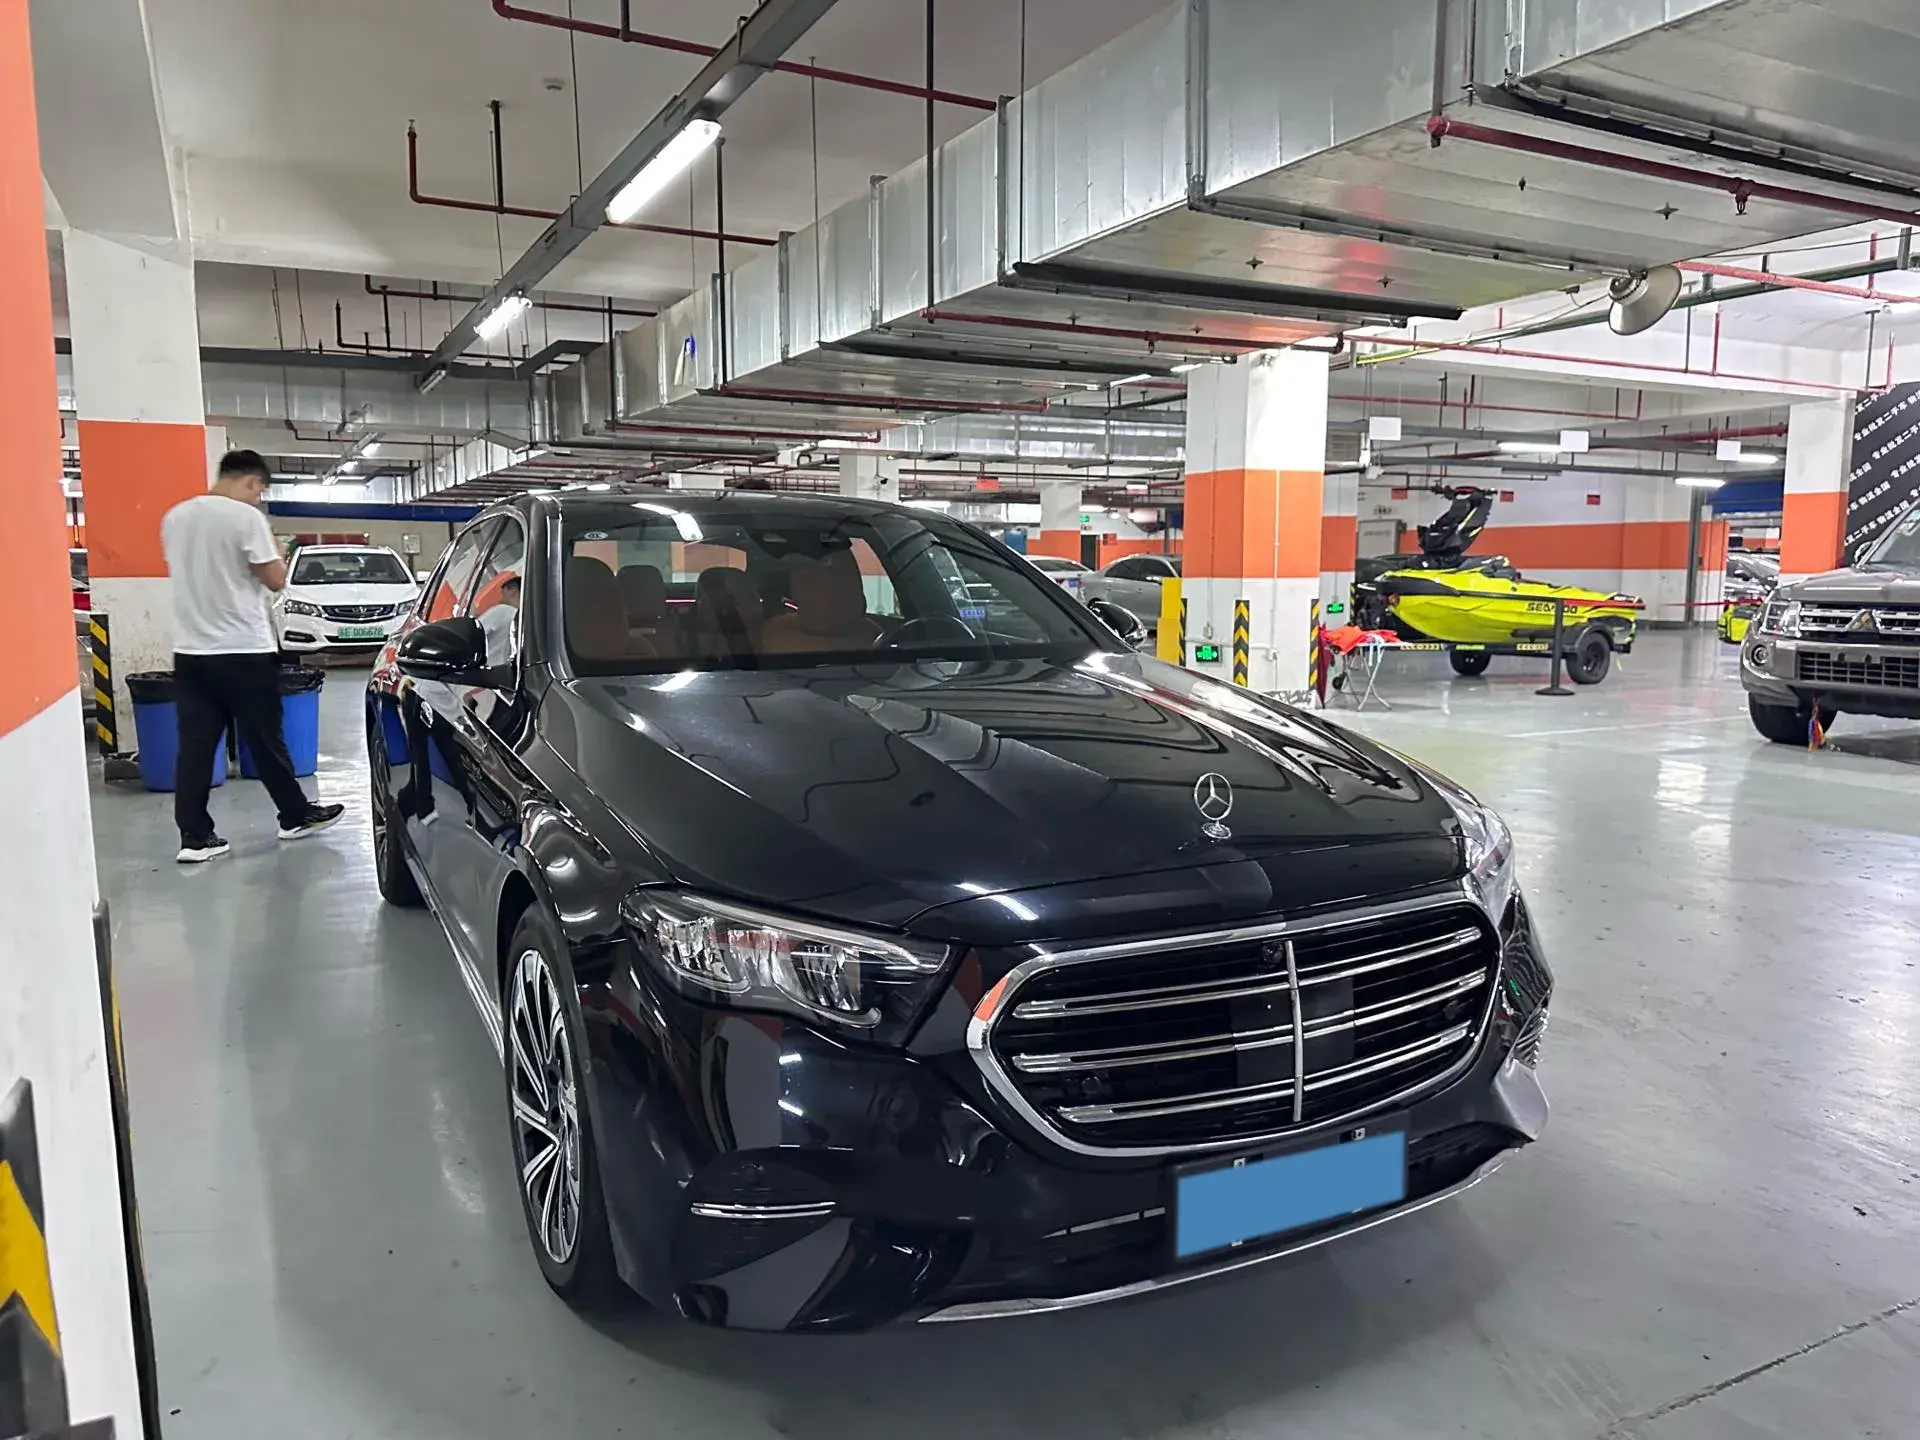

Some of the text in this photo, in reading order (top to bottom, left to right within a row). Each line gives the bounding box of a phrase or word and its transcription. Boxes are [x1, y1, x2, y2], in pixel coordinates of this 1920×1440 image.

[1872, 421, 1920, 460] 专业批发二手
